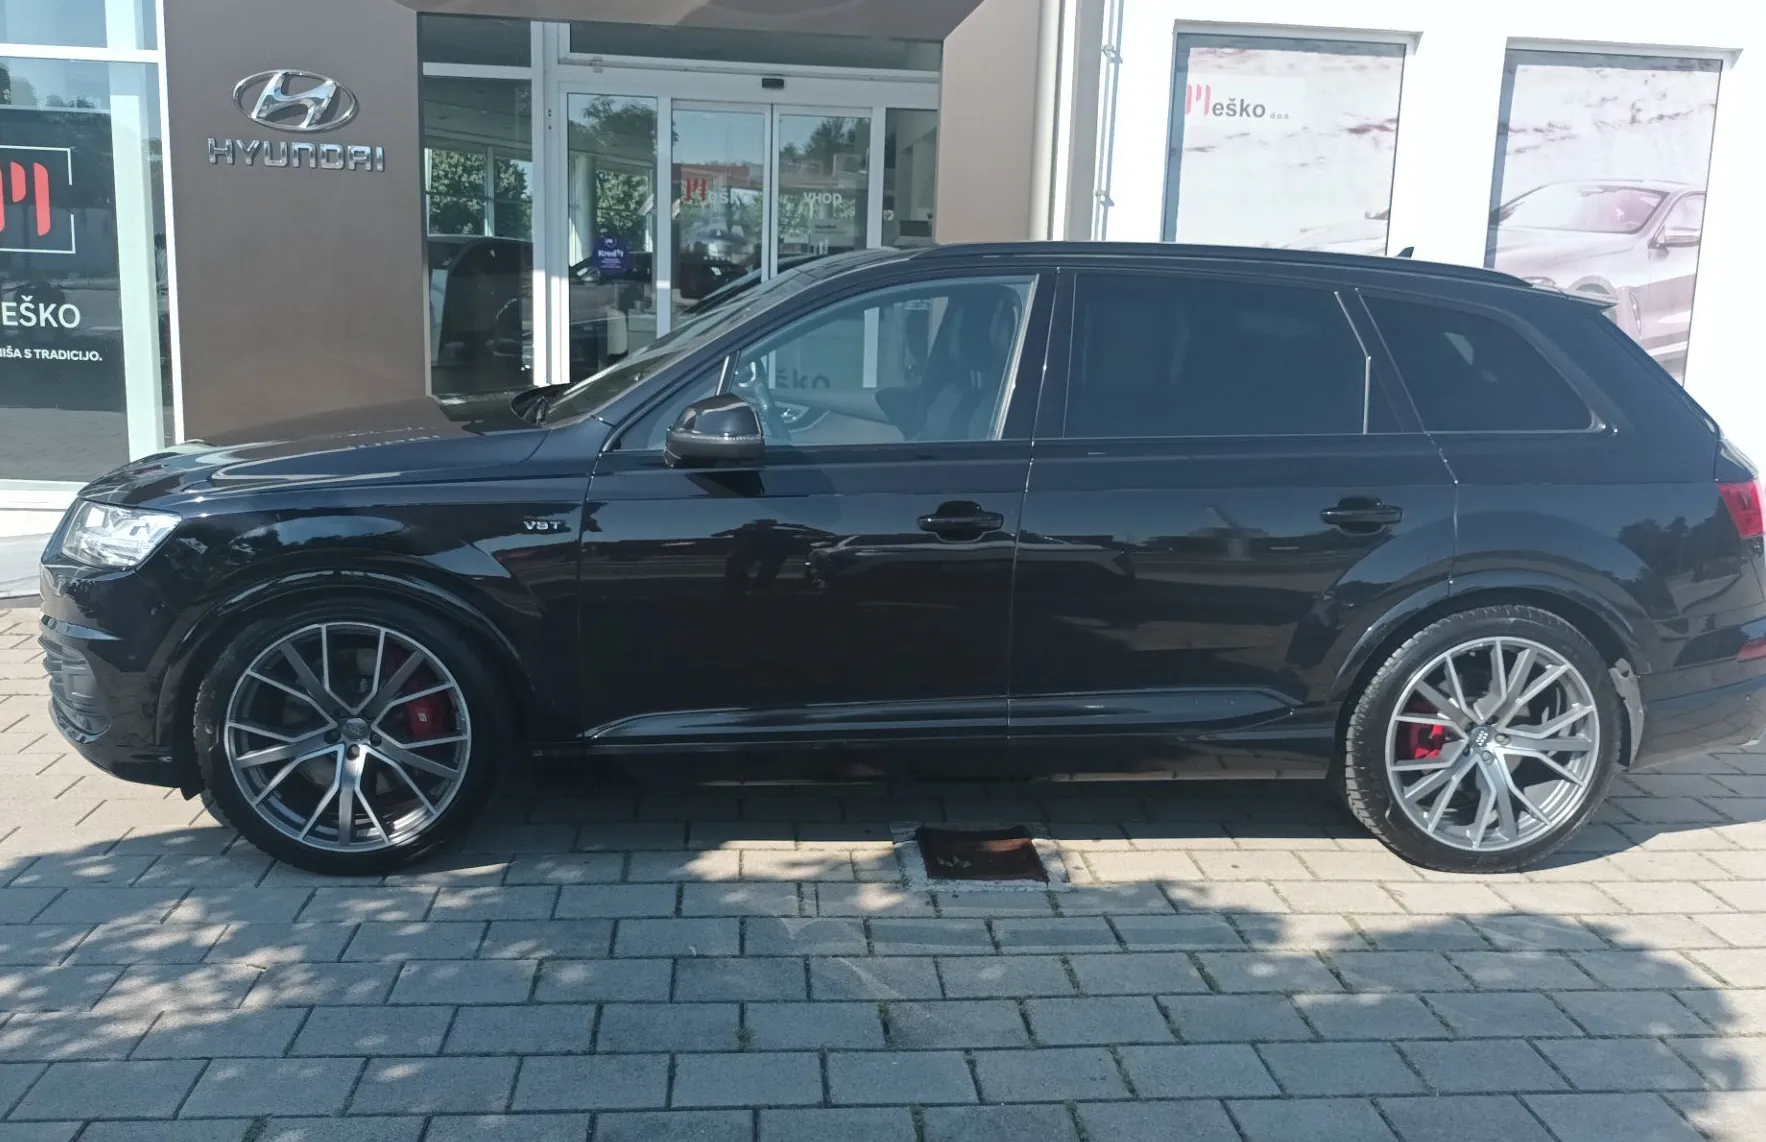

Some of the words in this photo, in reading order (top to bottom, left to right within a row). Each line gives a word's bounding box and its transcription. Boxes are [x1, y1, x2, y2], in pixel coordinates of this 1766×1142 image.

[207, 137, 385, 172] HYUNDAI
[803, 191, 843, 205] VHOD
[1, 295, 81, 329] EŠKO
[0, 345, 22, 358] IŠA
[24, 348, 32, 359] S
[33, 349, 103, 361] TRADICIJO.
